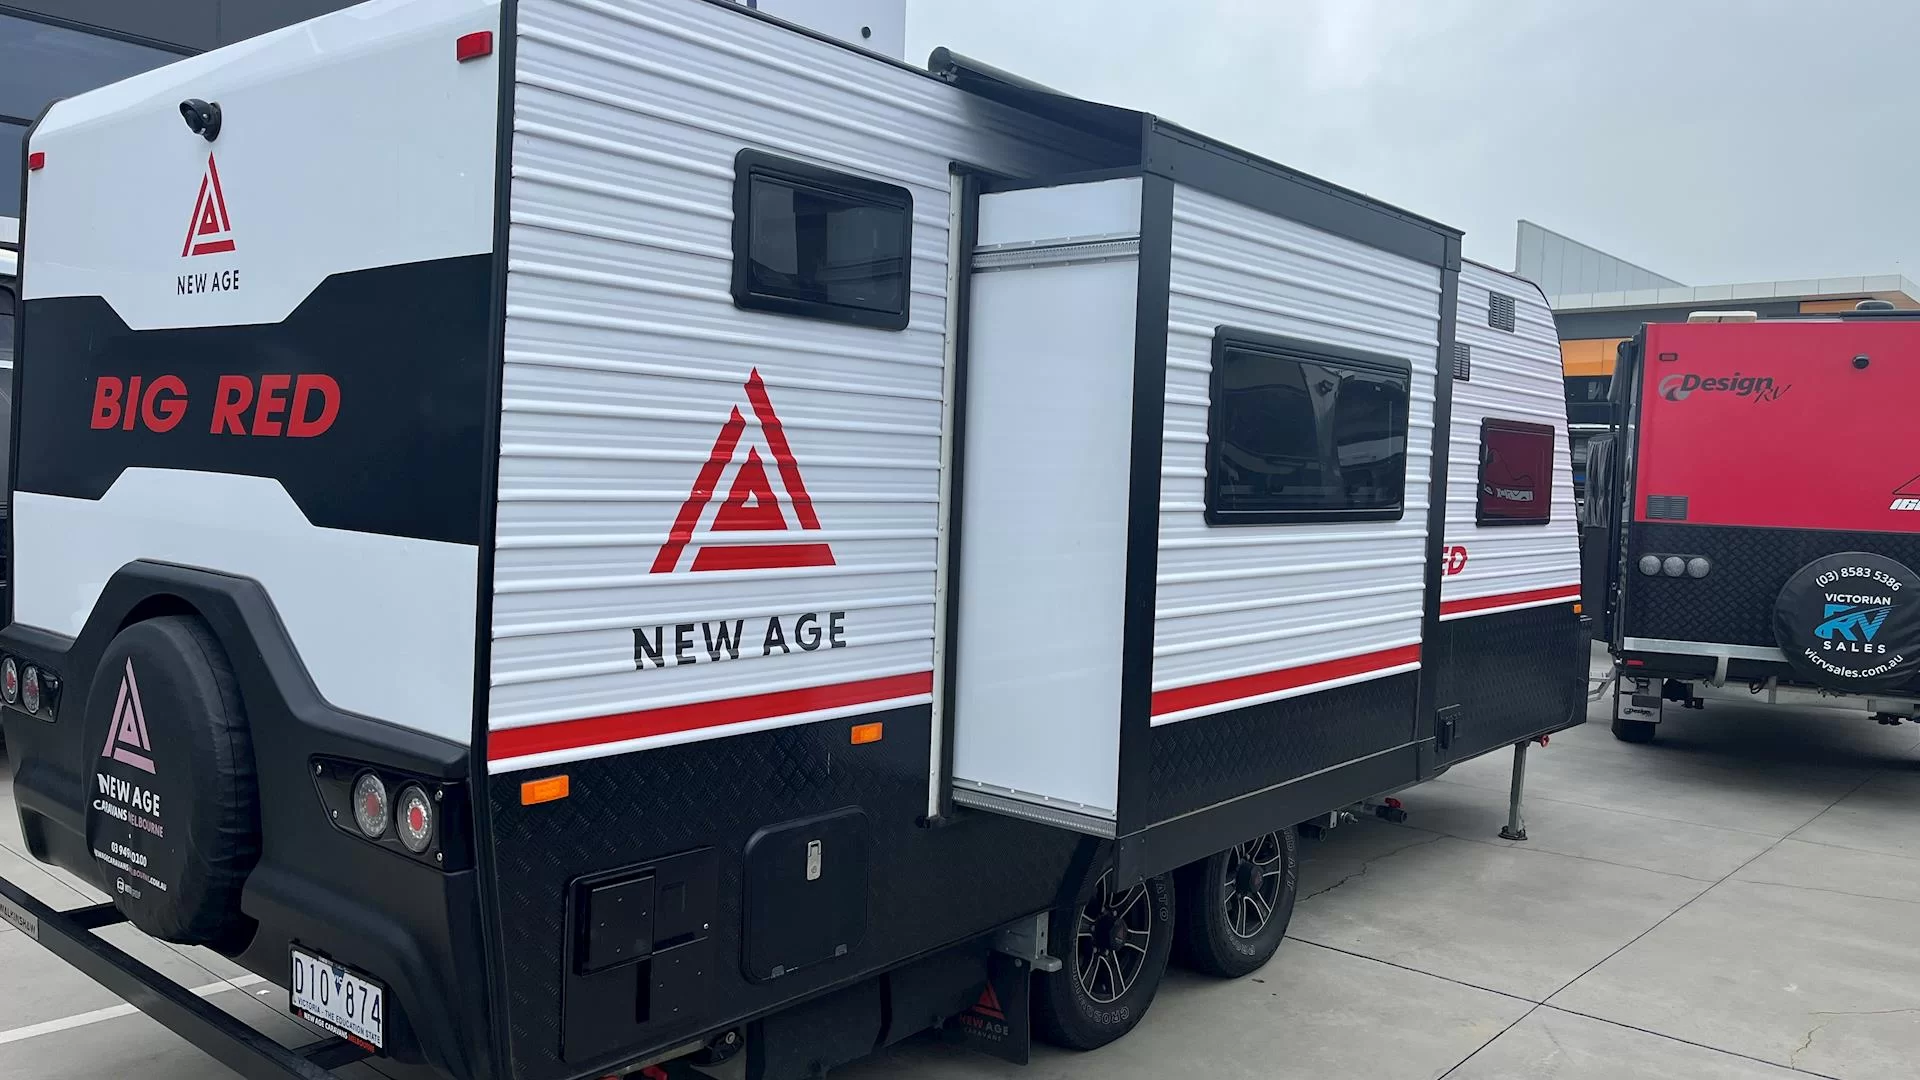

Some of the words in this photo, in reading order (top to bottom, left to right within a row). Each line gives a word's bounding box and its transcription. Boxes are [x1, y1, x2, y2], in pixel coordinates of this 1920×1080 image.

[177, 272, 207, 296] NEW
[211, 269, 239, 292] AGE
[1680, 372, 1773, 396] Design
[90, 374, 189, 433] BIG
[209, 373, 341, 438] RED
[1815, 570, 1839, 588] (03)
[1841, 567, 1871, 578] 8583
[1873, 571, 1902, 591] 5386
[1825, 593, 1891, 605] VICTORIAN
[1814, 604, 1894, 642] RV
[632, 619, 744, 670] NEW
[763, 611, 847, 656] AGE
[1823, 641, 1886, 654] SALES
[1804, 648, 1904, 678] vicrvsales.com.au
[97, 773, 131, 803] NEW
[132, 786, 160, 817] AGE
[93, 799, 128, 821] CARAVANS
[111, 841, 118, 853] 03
[295, 957, 329, 1006] D10
[346, 980, 381, 1033] 874
[298, 997, 320, 1014] VICTORIA
[325, 1009, 335, 1020] THE
[335, 1015, 365, 1035] EDUCATION
[365, 1029, 381, 1044] STATE
[303, 1012, 315, 1022] NEW
[315, 1016, 325, 1028] AGE
[986, 1021, 1009, 1036] AGE
